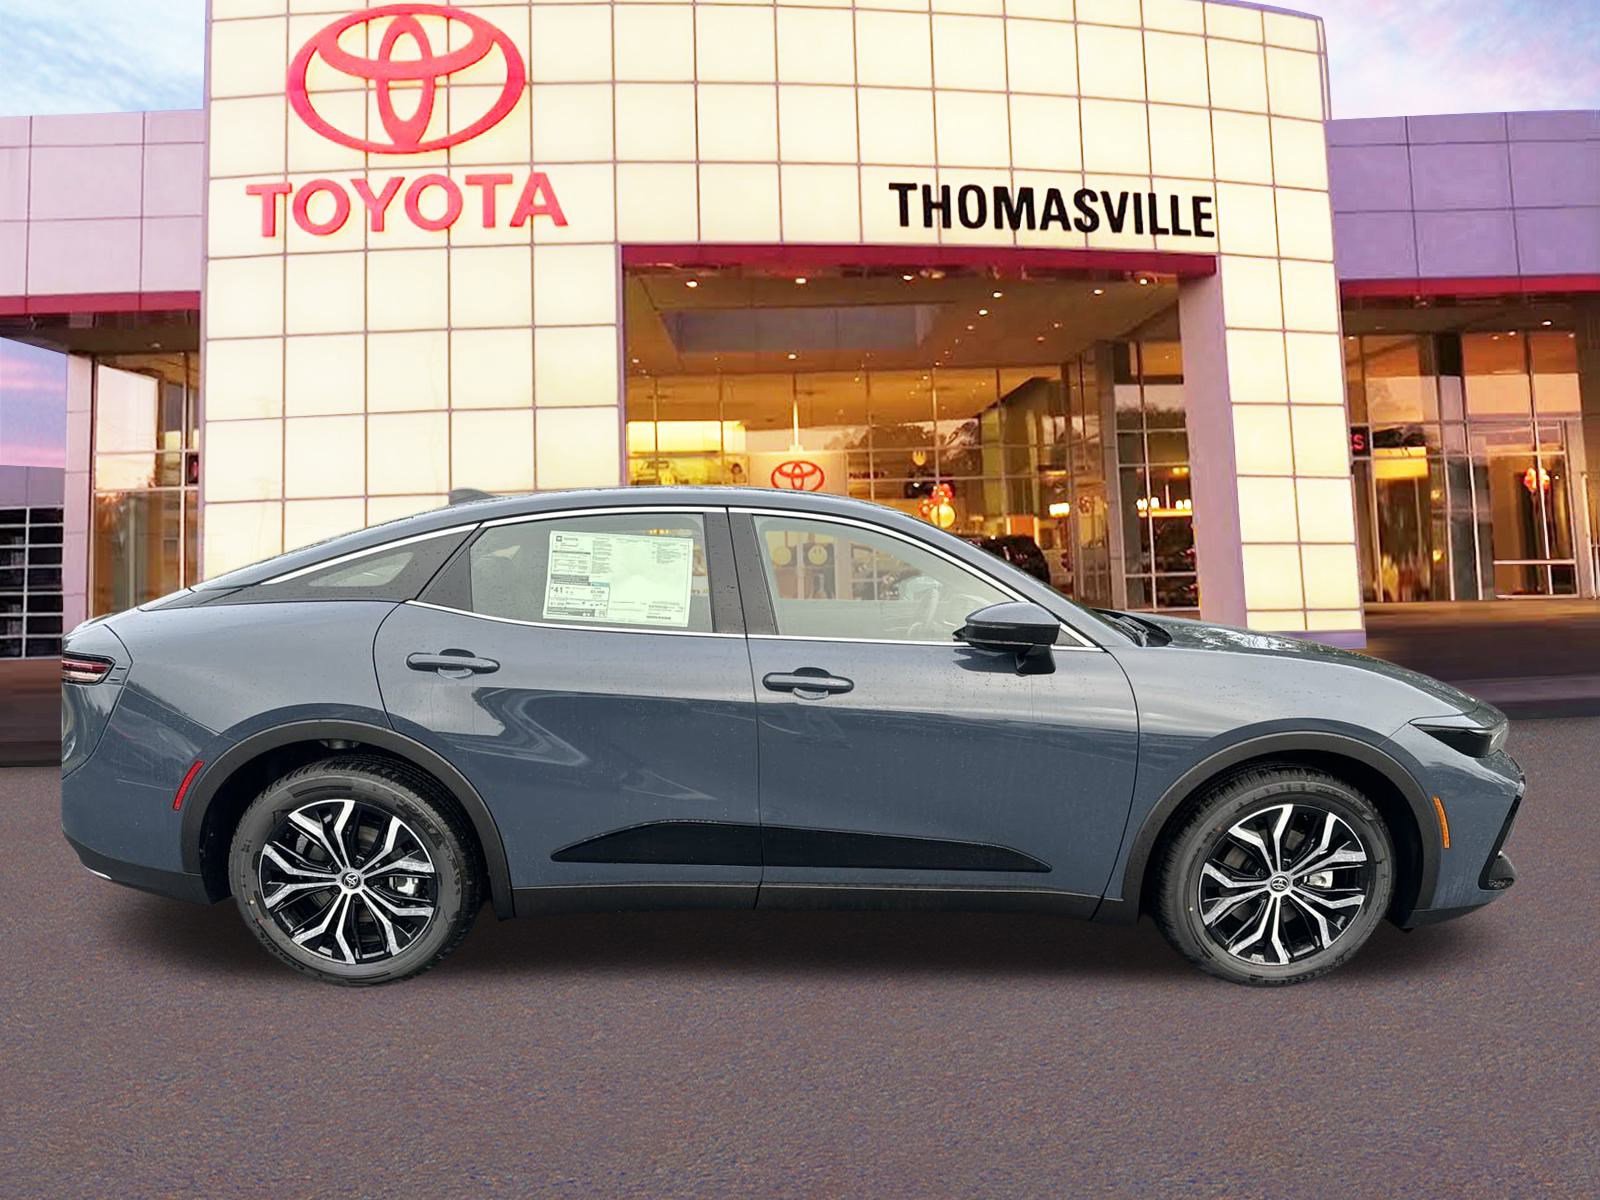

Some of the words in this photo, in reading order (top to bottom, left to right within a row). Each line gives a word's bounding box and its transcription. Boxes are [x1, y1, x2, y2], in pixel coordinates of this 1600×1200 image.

[246, 172, 568, 238] TOYOTA
[888, 182, 1215, 238] THOMASVILLE
[1351, 434, 1365, 450] S
